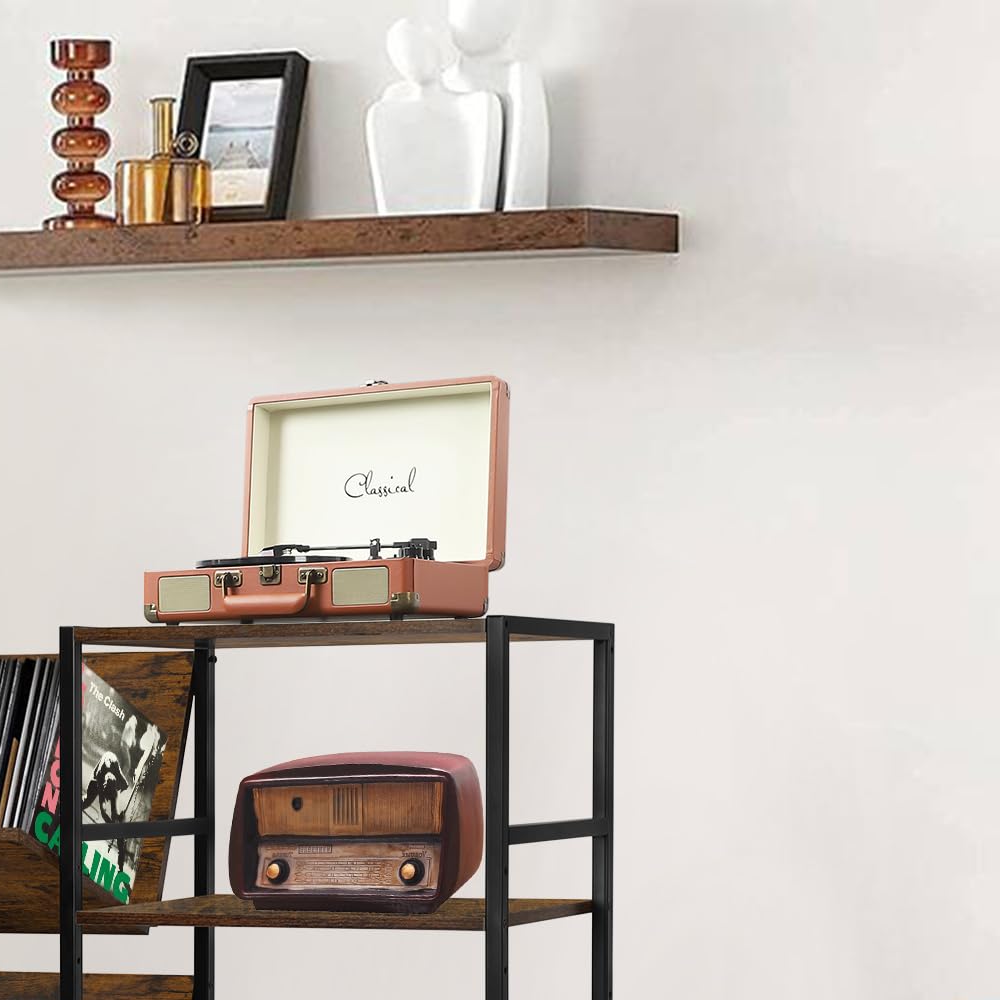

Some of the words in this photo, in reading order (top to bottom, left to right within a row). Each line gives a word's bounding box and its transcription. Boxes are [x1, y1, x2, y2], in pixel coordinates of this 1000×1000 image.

[344, 466, 417, 498] Classical
[89, 681, 104, 701] The
[104, 696, 125, 721] Clash
